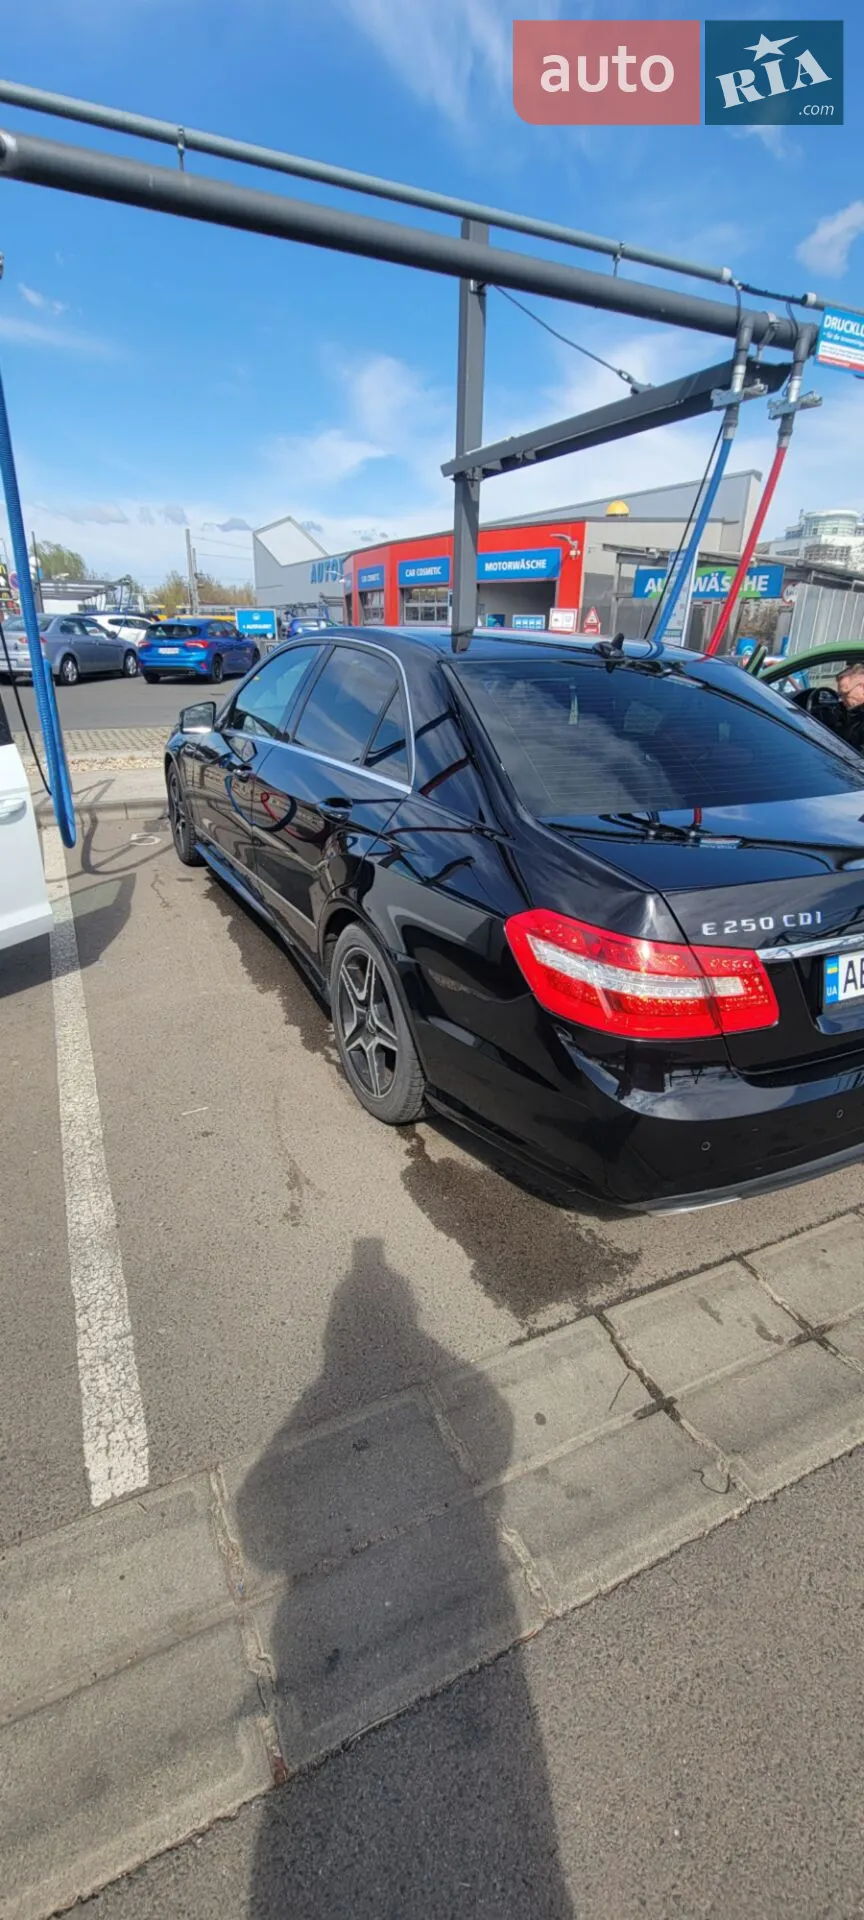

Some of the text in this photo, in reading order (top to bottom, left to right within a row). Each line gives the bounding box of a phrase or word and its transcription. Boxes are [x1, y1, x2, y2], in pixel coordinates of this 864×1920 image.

[484, 558, 547, 571] MOTORWÄSCHE
[701, 911, 822, 936] E 250 CDI
[826, 984, 838, 997] UA
